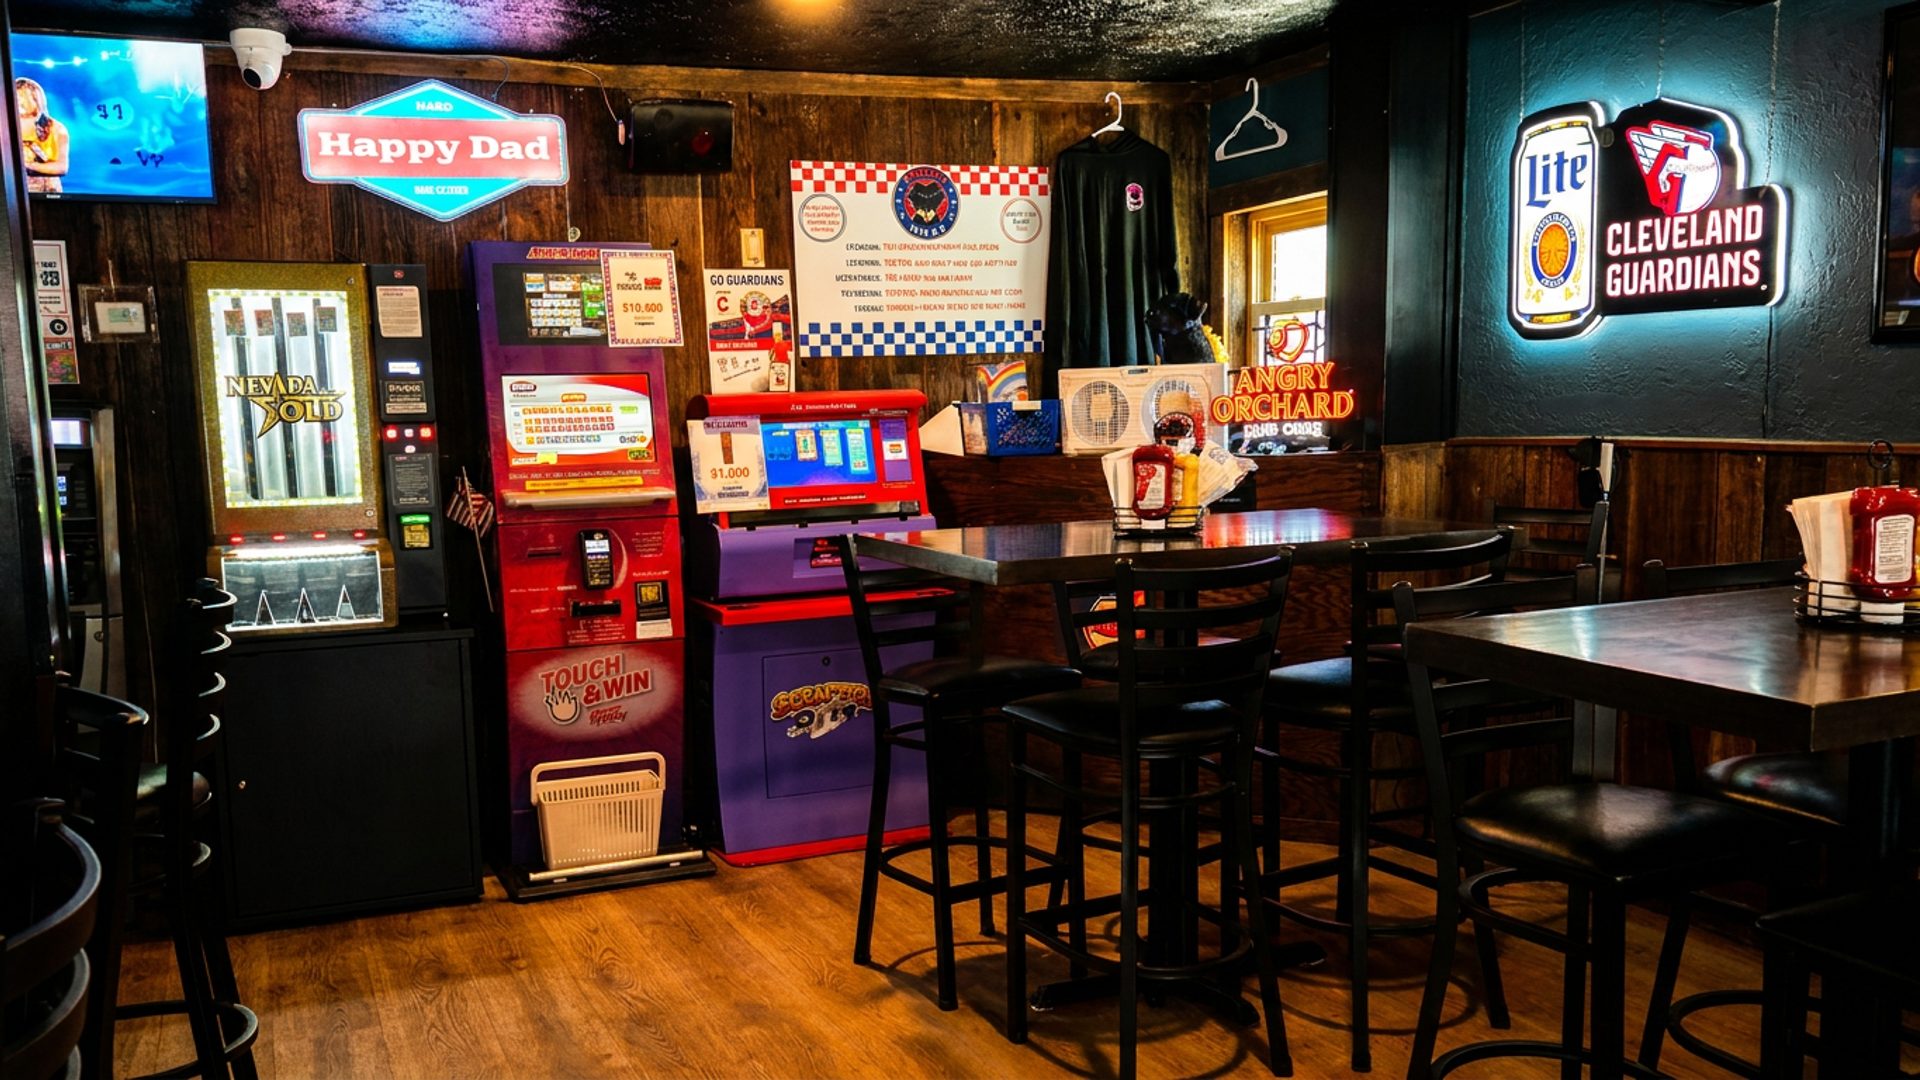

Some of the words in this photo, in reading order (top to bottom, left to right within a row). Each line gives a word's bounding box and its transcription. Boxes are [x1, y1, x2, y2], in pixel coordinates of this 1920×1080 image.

[318, 132, 460, 164] Happy
[469, 136, 550, 160] Dad
[1526, 151, 1588, 209] Lite
[1606, 204, 1763, 257] CLEVELAND
[710, 275, 724, 285] GO
[726, 275, 784, 285] GUARDIANS
[224, 372, 319, 397] NEVADA
[1235, 362, 1335, 394] ANGRY
[1212, 391, 1354, 423] ORCHARD
[541, 655, 621, 694] TOUCH
[583, 684, 601, 705] &
[602, 670, 650, 700] WIN
